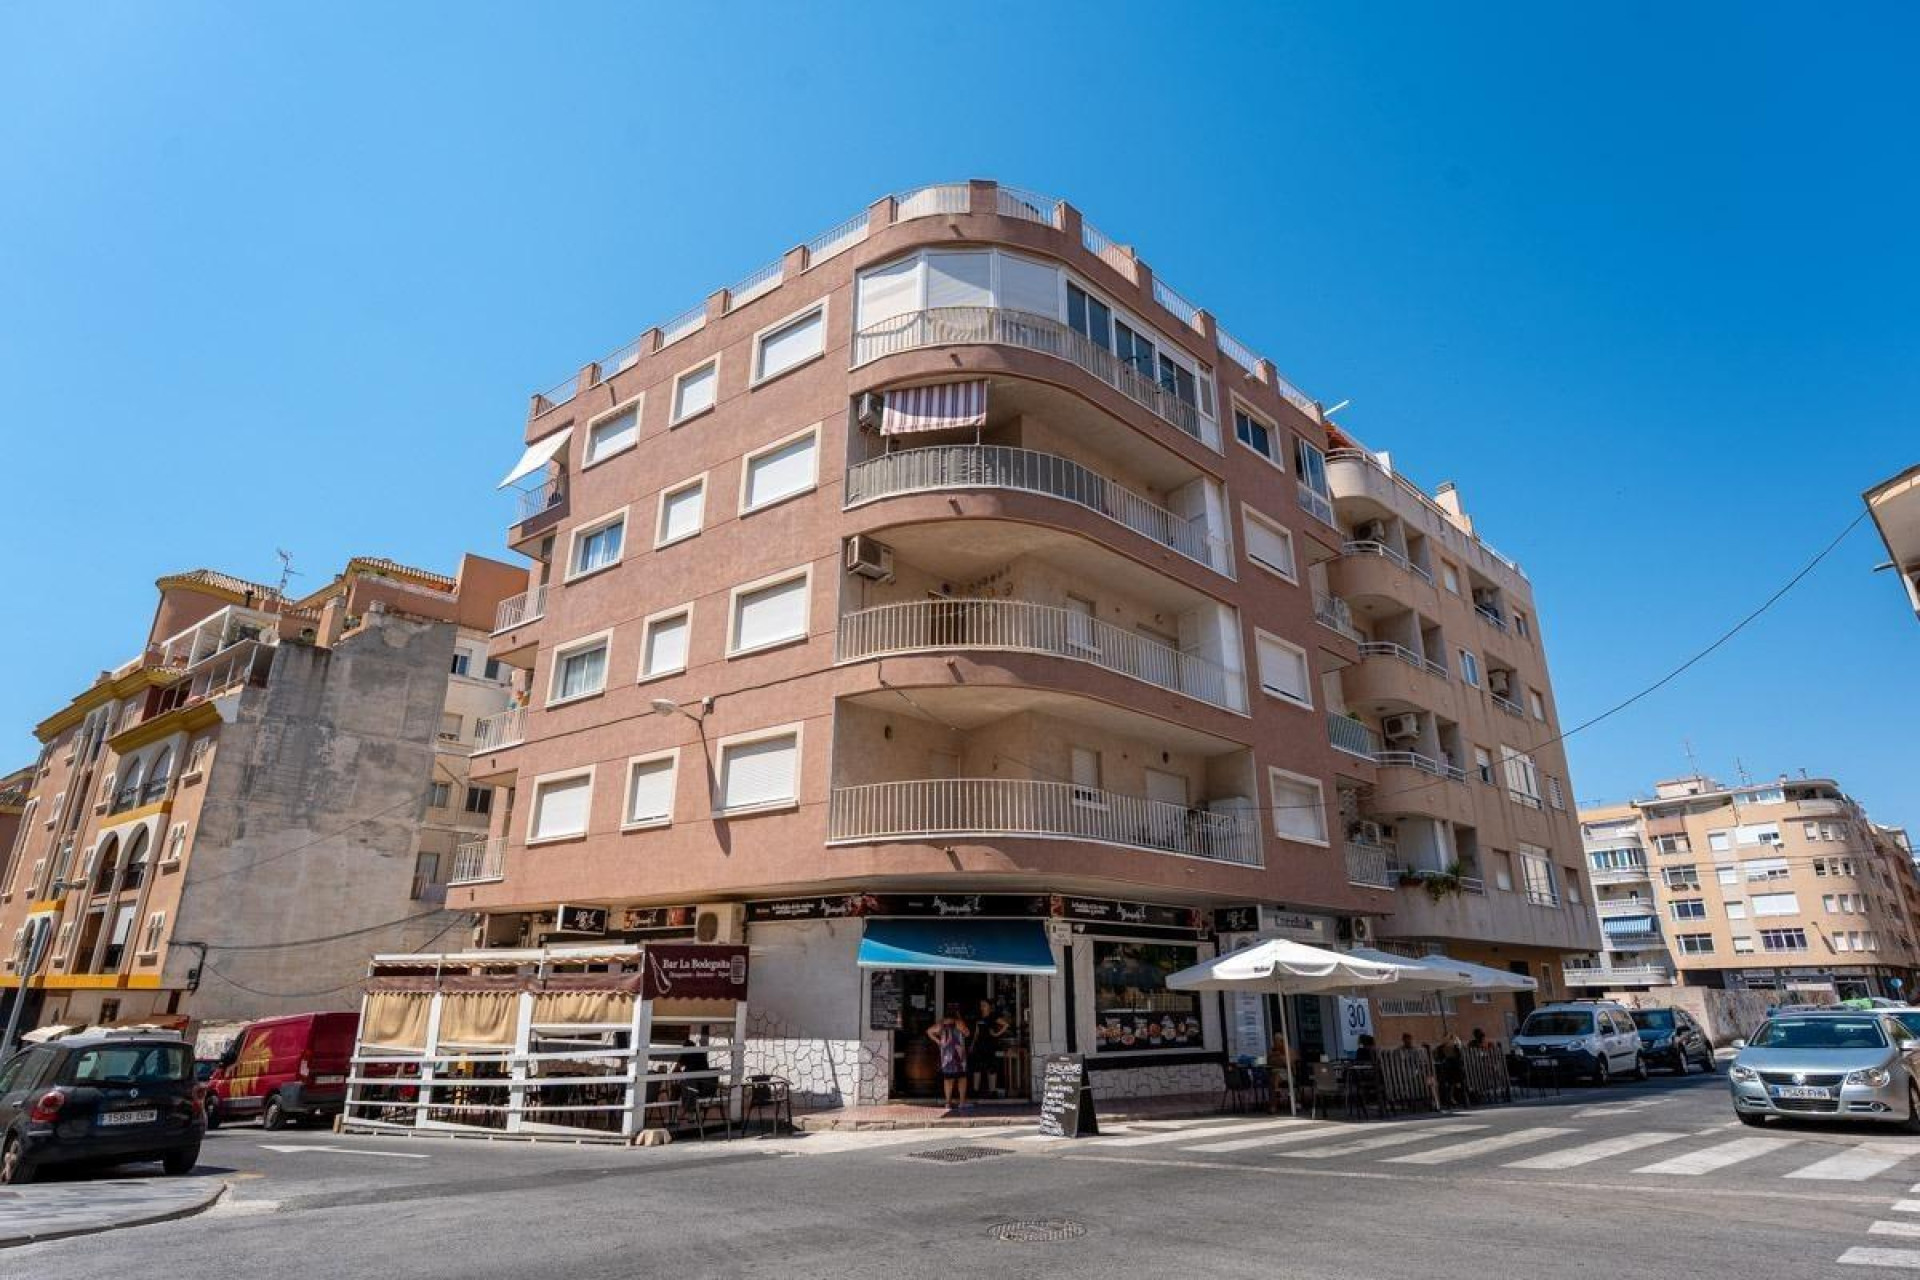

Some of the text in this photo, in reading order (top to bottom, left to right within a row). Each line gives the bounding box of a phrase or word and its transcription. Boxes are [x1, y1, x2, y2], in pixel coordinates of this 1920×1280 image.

[662, 958, 678, 969] Bar
[679, 958, 690, 969] La
[1347, 1004, 1366, 1028] 30
